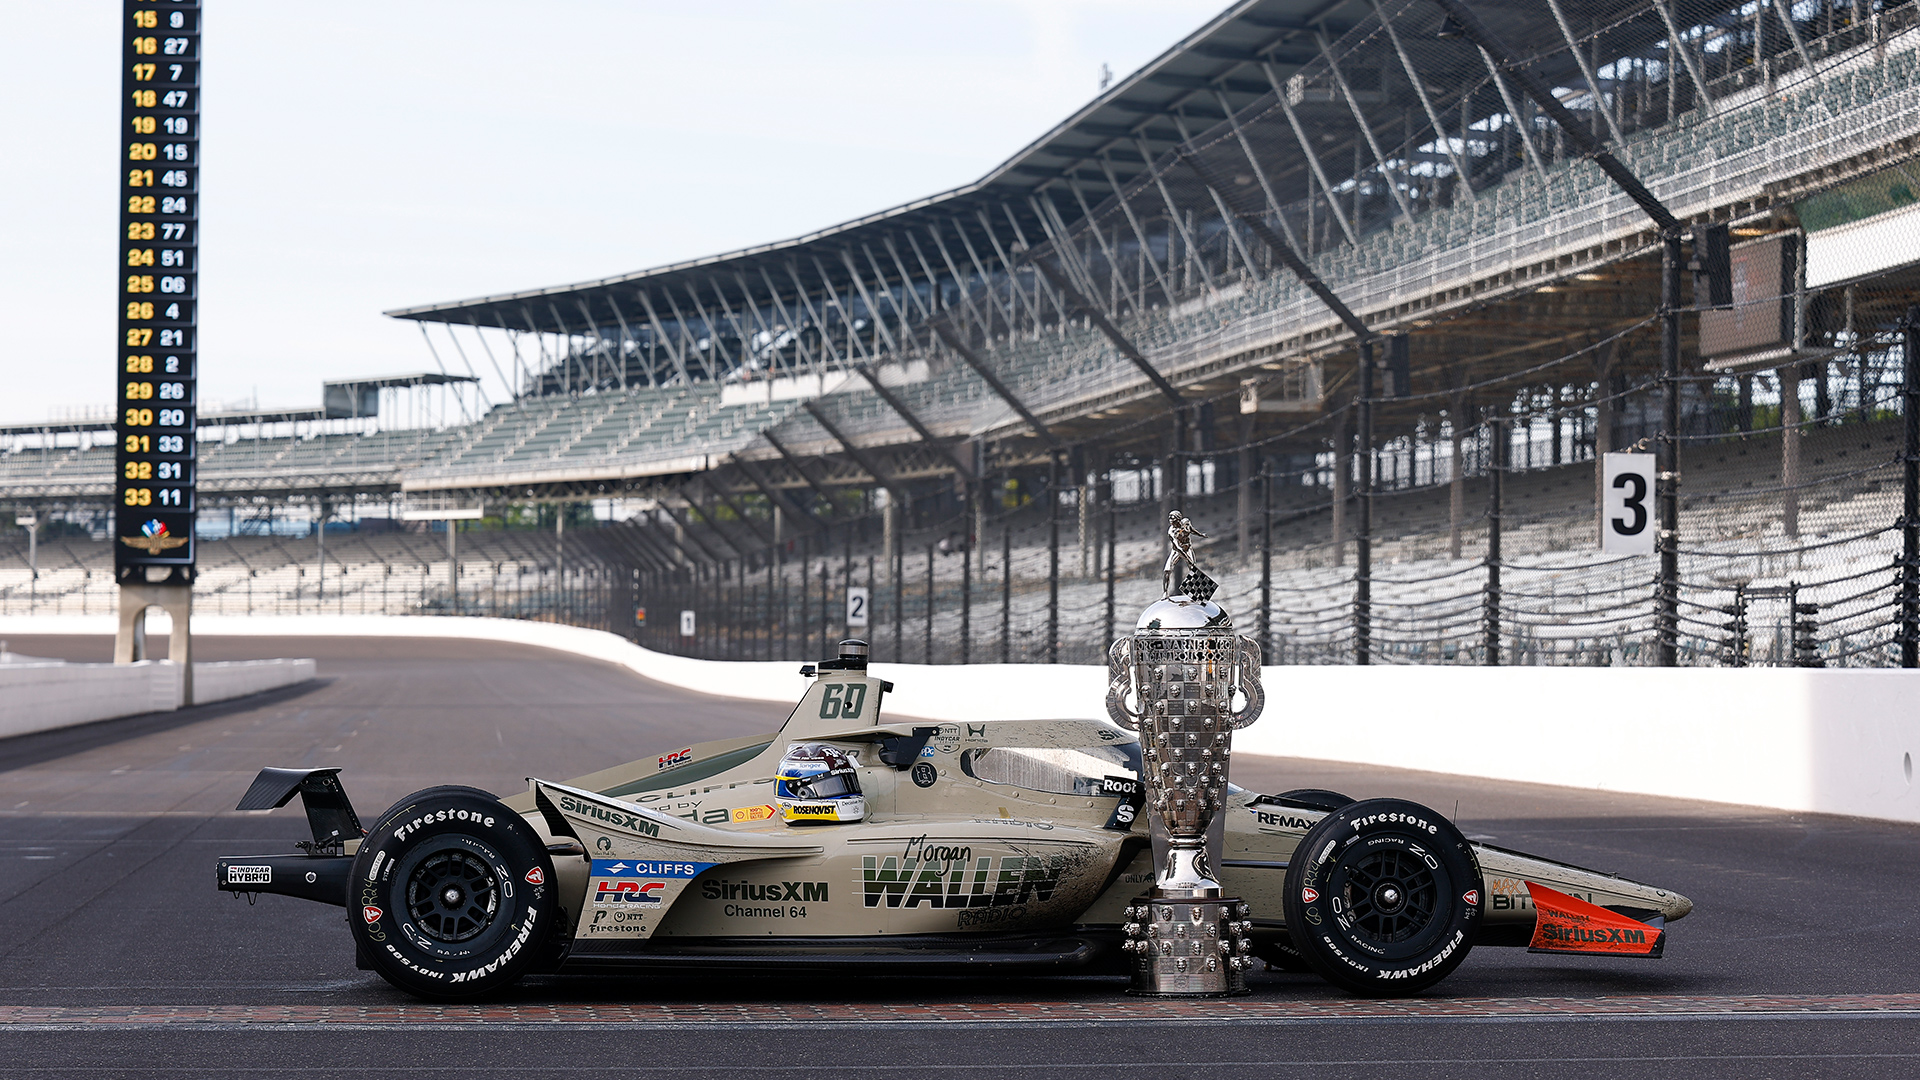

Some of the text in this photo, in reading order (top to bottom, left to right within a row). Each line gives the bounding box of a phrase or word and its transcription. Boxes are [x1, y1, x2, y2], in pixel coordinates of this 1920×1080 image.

[133, 11, 184, 28] 15 9
[133, 37, 188, 54] 16 27
[132, 64, 183, 81] 17 7
[132, 90, 188, 107] 18 47
[132, 117, 188, 134] 19 19
[129, 143, 188, 160] 20 15
[129, 170, 187, 187] 21 45
[128, 196, 187, 213] 22 24
[128, 222, 186, 240] 23 77
[128, 249, 184, 266] 24 51
[127, 276, 185, 293] 25 06
[127, 302, 180, 319] 26 4
[127, 329, 183, 346] 27 21
[126, 356, 179, 372] 28 2
[126, 382, 184, 399] 29 26
[126, 409, 184, 426] 30 20
[125, 435, 183, 452] 31 33
[125, 462, 181, 479] 32 31
[125, 489, 181, 506] 33 11
[1611, 473, 1648, 536] 3
[850, 596, 864, 618] 2
[685, 617, 691, 629] 1
[819, 683, 868, 719] 60
[658, 748, 692, 769] HRC
[560, 796, 660, 837] SiriusXM
[793, 805, 836, 815] ROSENQVIST
[394, 808, 495, 841] Firestone
[1257, 811, 1317, 830] REMAX
[1350, 812, 1439, 835] Firestone
[903, 834, 971, 876] Morgan
[635, 862, 695, 875] CLIFFS
[861, 855, 1064, 909] WALLEN
[1491, 878, 1522, 899] MAX
[594, 881, 667, 904] HRC
[701, 880, 829, 902] SiriusXM
[627, 913, 643, 921] NTT
[724, 904, 807, 918] Channel 64
[957, 907, 1026, 927] RADIO
[589, 924, 646, 933] Firestone
[1542, 923, 1646, 944] SiriusXM
[386, 905, 538, 983] FIREHAWK INDY 500
[1323, 930, 1464, 980] FIREHAWK INDY 500
